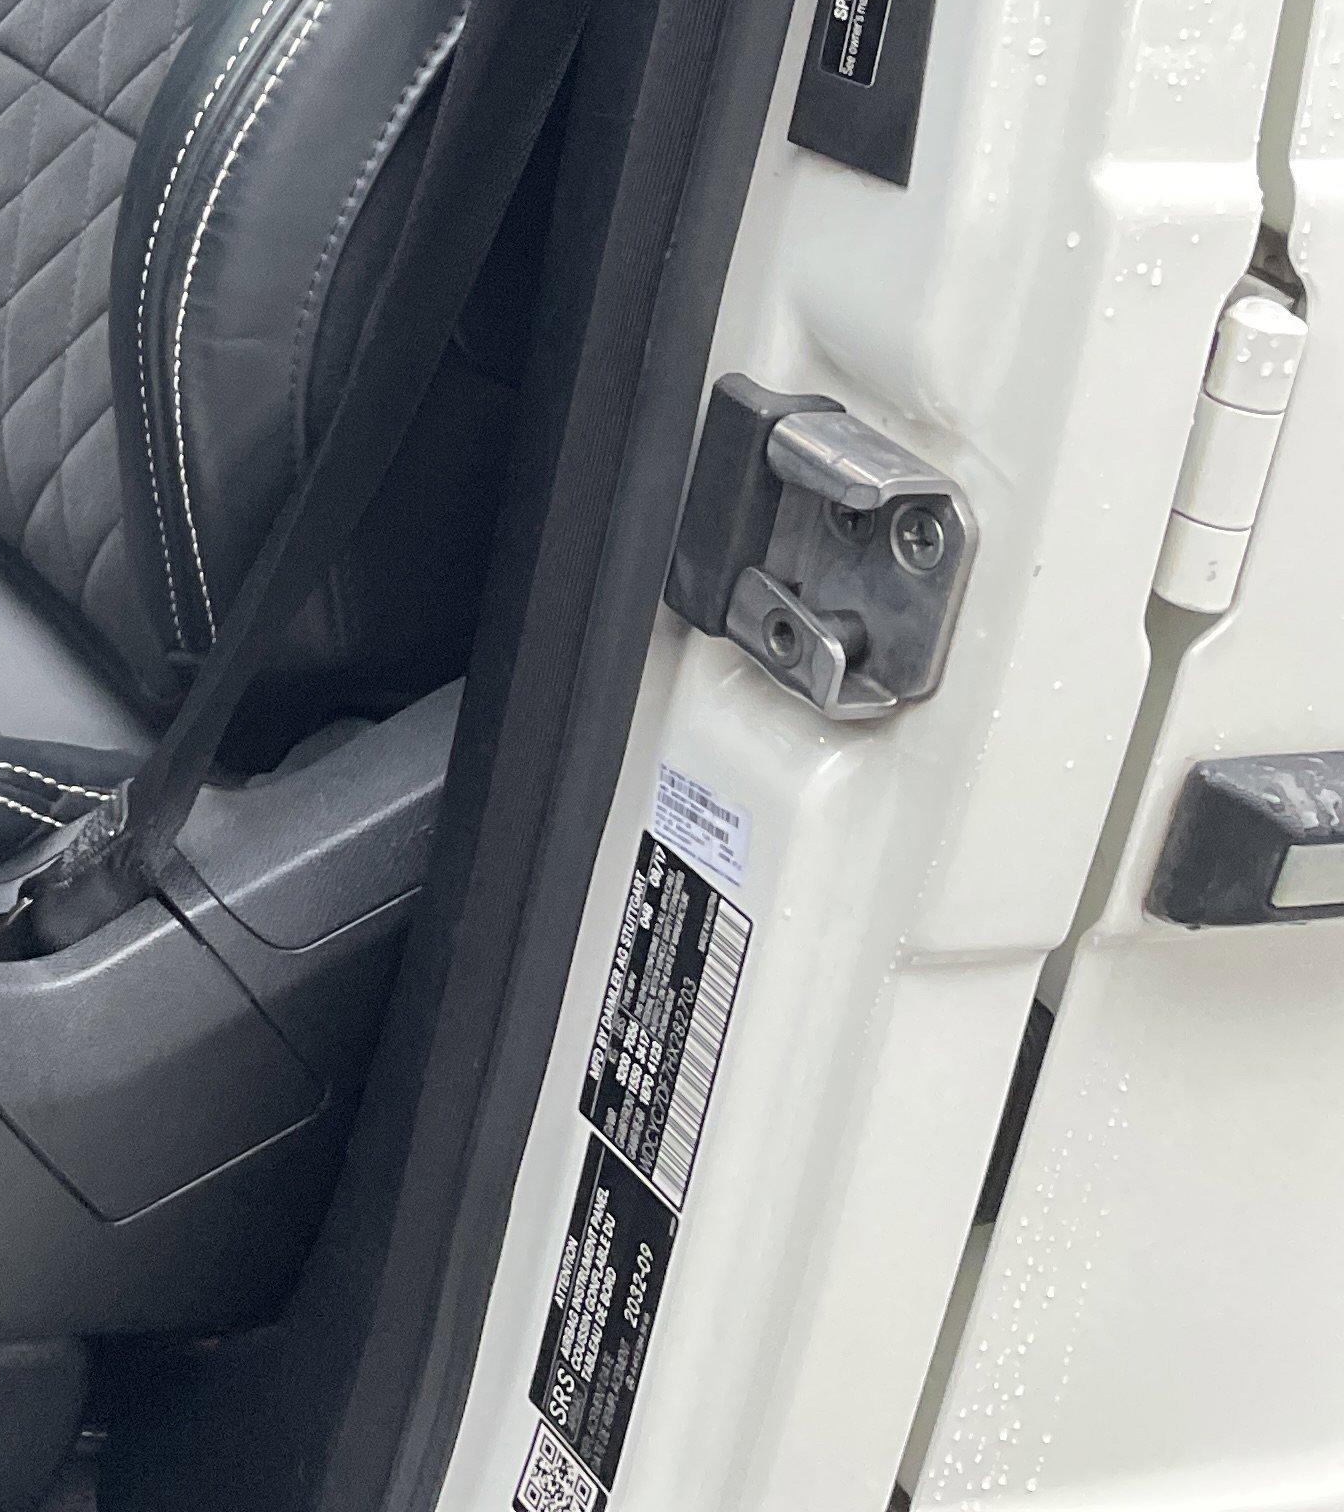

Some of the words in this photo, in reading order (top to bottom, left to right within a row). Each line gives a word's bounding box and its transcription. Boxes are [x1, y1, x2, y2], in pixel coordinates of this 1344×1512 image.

[620, 869, 646, 948] STUTTGART
[615, 946, 629, 971] AG
[601, 968, 623, 1030] DAIMLER
[589, 1047, 605, 1081] MFD
[596, 1027, 609, 1050] BY
[554, 1235, 578, 1308] ATTENTION
[560, 1309, 579, 1361] AIRBAG
[571, 1226, 598, 1312] INSTRUMENT
[590, 1187, 609, 1230] PANEL
[570, 1309, 592, 1371] COUSSIN
[584, 1234, 611, 1312] GONFLABLE
[602, 1212, 616, 1238] DU
[599, 1266, 617, 1307] BORD
[623, 1242, 653, 1328] 2032-09
[594, 1302, 608, 1327] DE
[580, 1323, 603, 1382] TABLEAU
[549, 1368, 575, 1425] SRS
